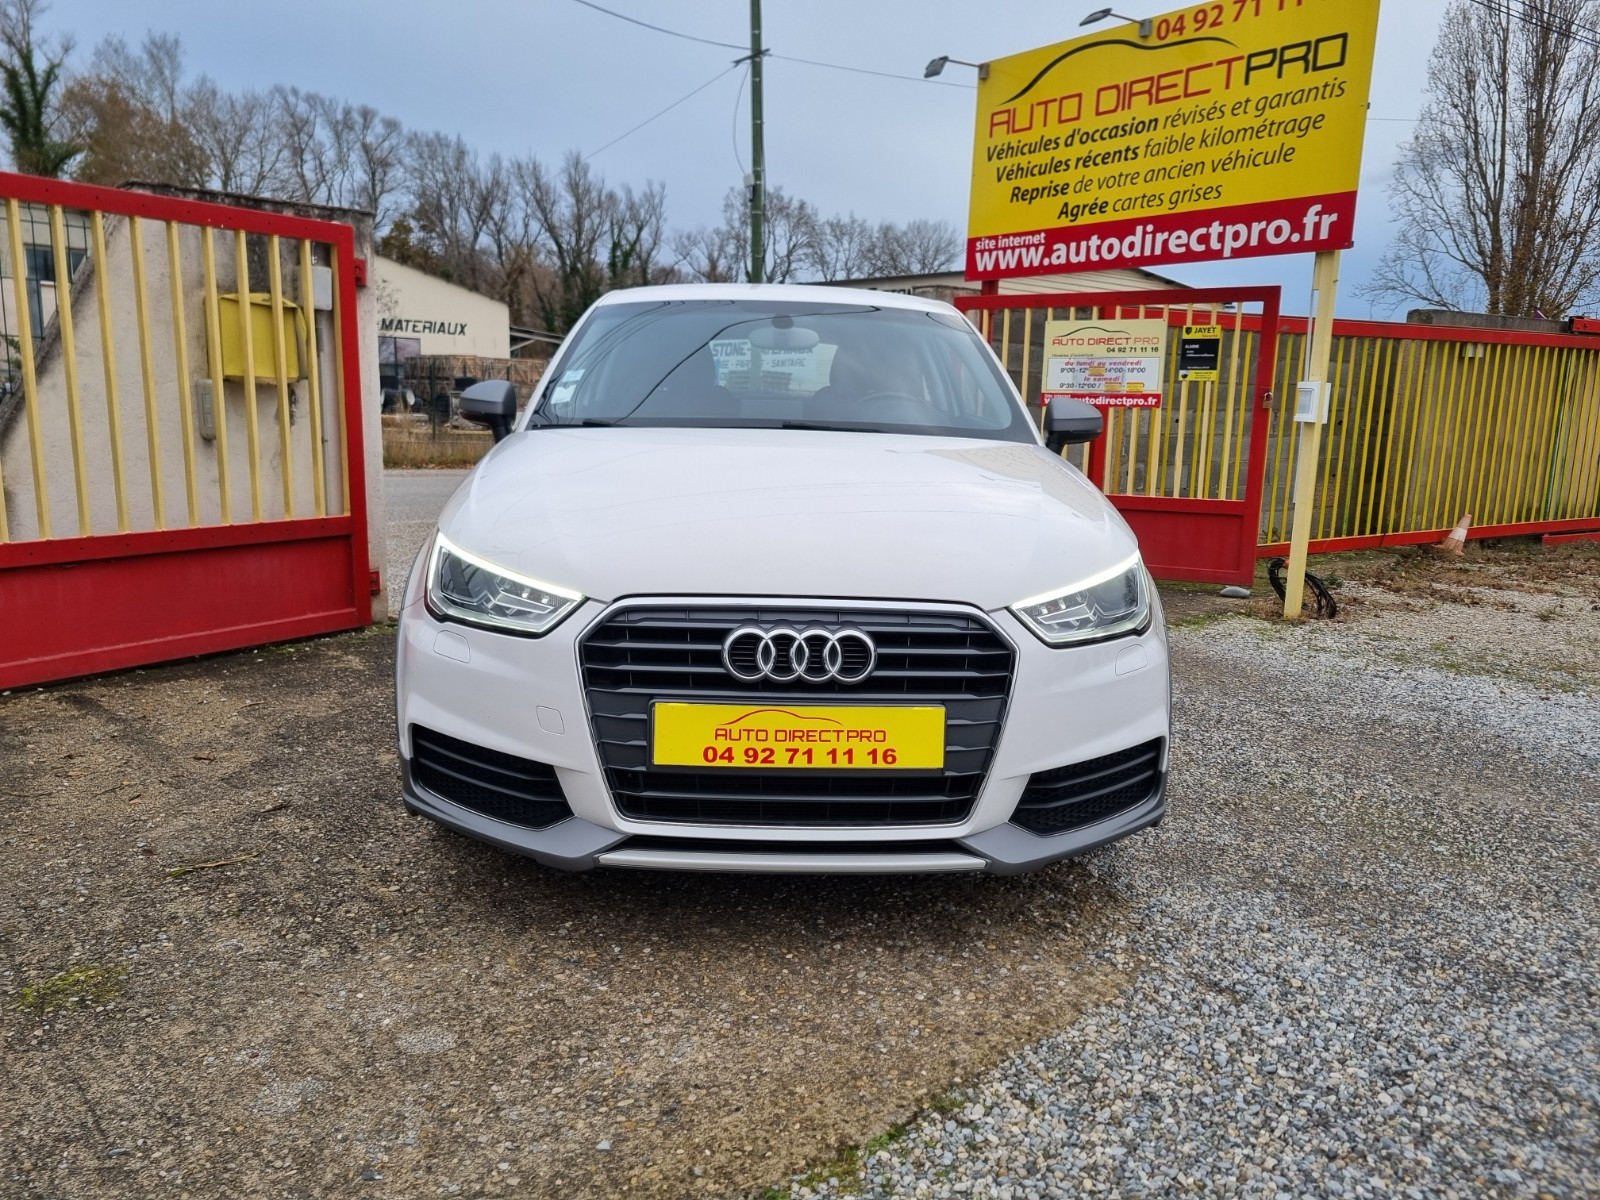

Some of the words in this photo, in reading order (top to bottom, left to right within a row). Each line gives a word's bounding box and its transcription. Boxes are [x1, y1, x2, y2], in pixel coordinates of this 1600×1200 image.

[1156, 14, 1186, 41] 04
[1193, 4, 1224, 32] 92
[987, 136, 1060, 162] Véhicules
[1064, 116, 1159, 148] d'occasion
[1163, 100, 1225, 130] révisés
[1231, 100, 1251, 117] et
[1254, 78, 1347, 118] garantis
[989, 92, 1083, 138] AUTO
[996, 156, 1071, 183] Véhicules
[1075, 142, 1140, 169] récents
[1144, 132, 1195, 159] faible
[1199, 112, 1326, 152] kilométrage
[1010, 181, 1070, 204] Reprise
[1073, 176, 1093, 194] de
[1097, 170, 1140, 191] votre
[1144, 159, 1205, 184] ancien
[1211, 143, 1296, 175] véhicule
[1057, 198, 1108, 223] Agrée
[1112, 193, 1164, 213] cartes
[1169, 185, 1223, 209] grises
[975, 204, 1338, 271] www.autodirectpro.fr
[975, 237, 995, 251] site
[998, 232, 1046, 249] internet
[1052, 338, 1084, 346] AUTO
[1088, 337, 1131, 345] DIRECT
[1134, 337, 1159, 345] PRO
[715, 728, 768, 742] AUTO
[703, 746, 734, 763] 04
[744, 748, 775, 764] 92
[785, 748, 812, 764] 71
[826, 748, 853, 764] 11
[866, 748, 897, 764] 16
